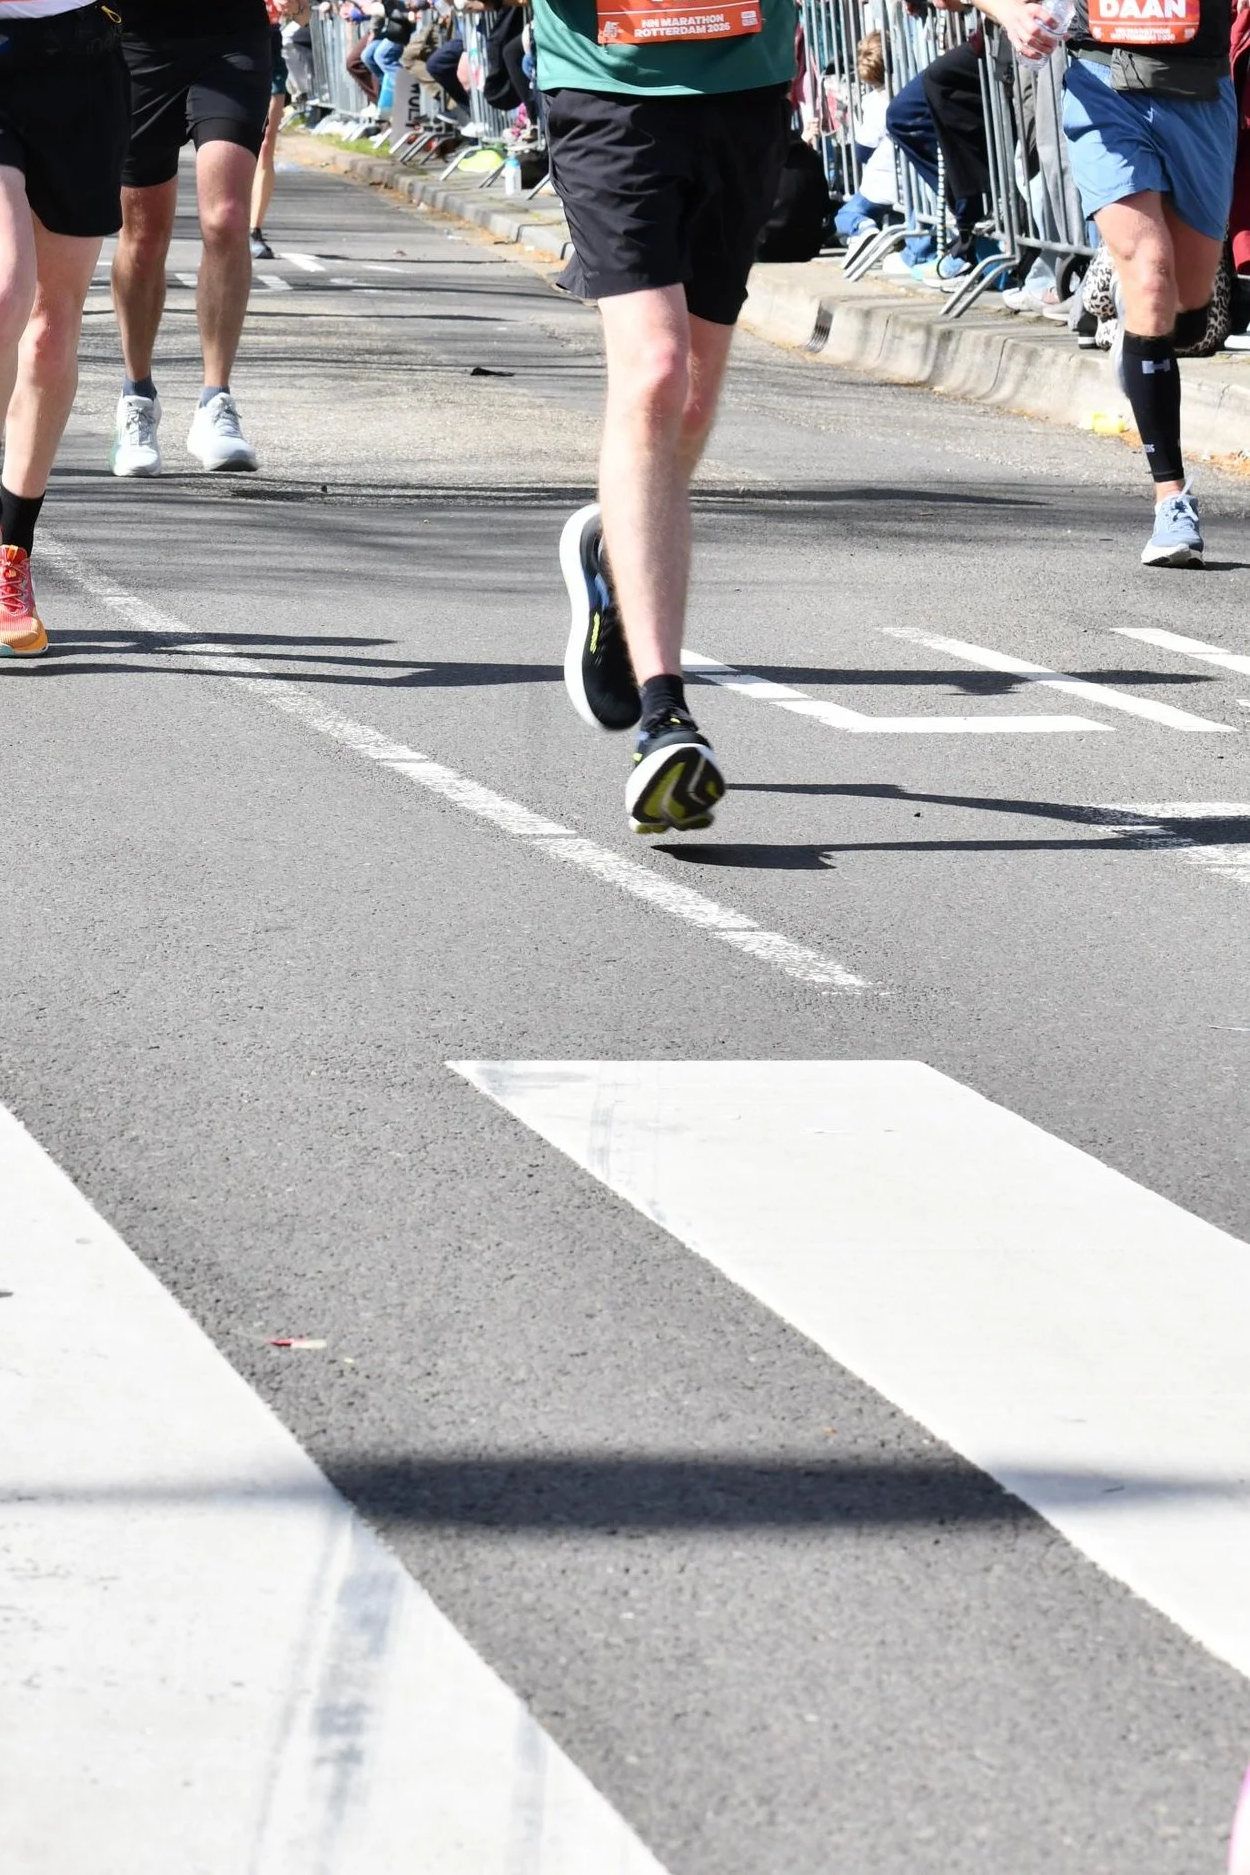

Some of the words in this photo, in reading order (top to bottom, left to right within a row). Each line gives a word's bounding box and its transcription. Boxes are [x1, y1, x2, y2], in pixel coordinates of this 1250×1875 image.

[641, 18, 660, 28] NN
[660, 13, 725, 27] MARATHON
[634, 25, 707, 38] ROTTERDAM
